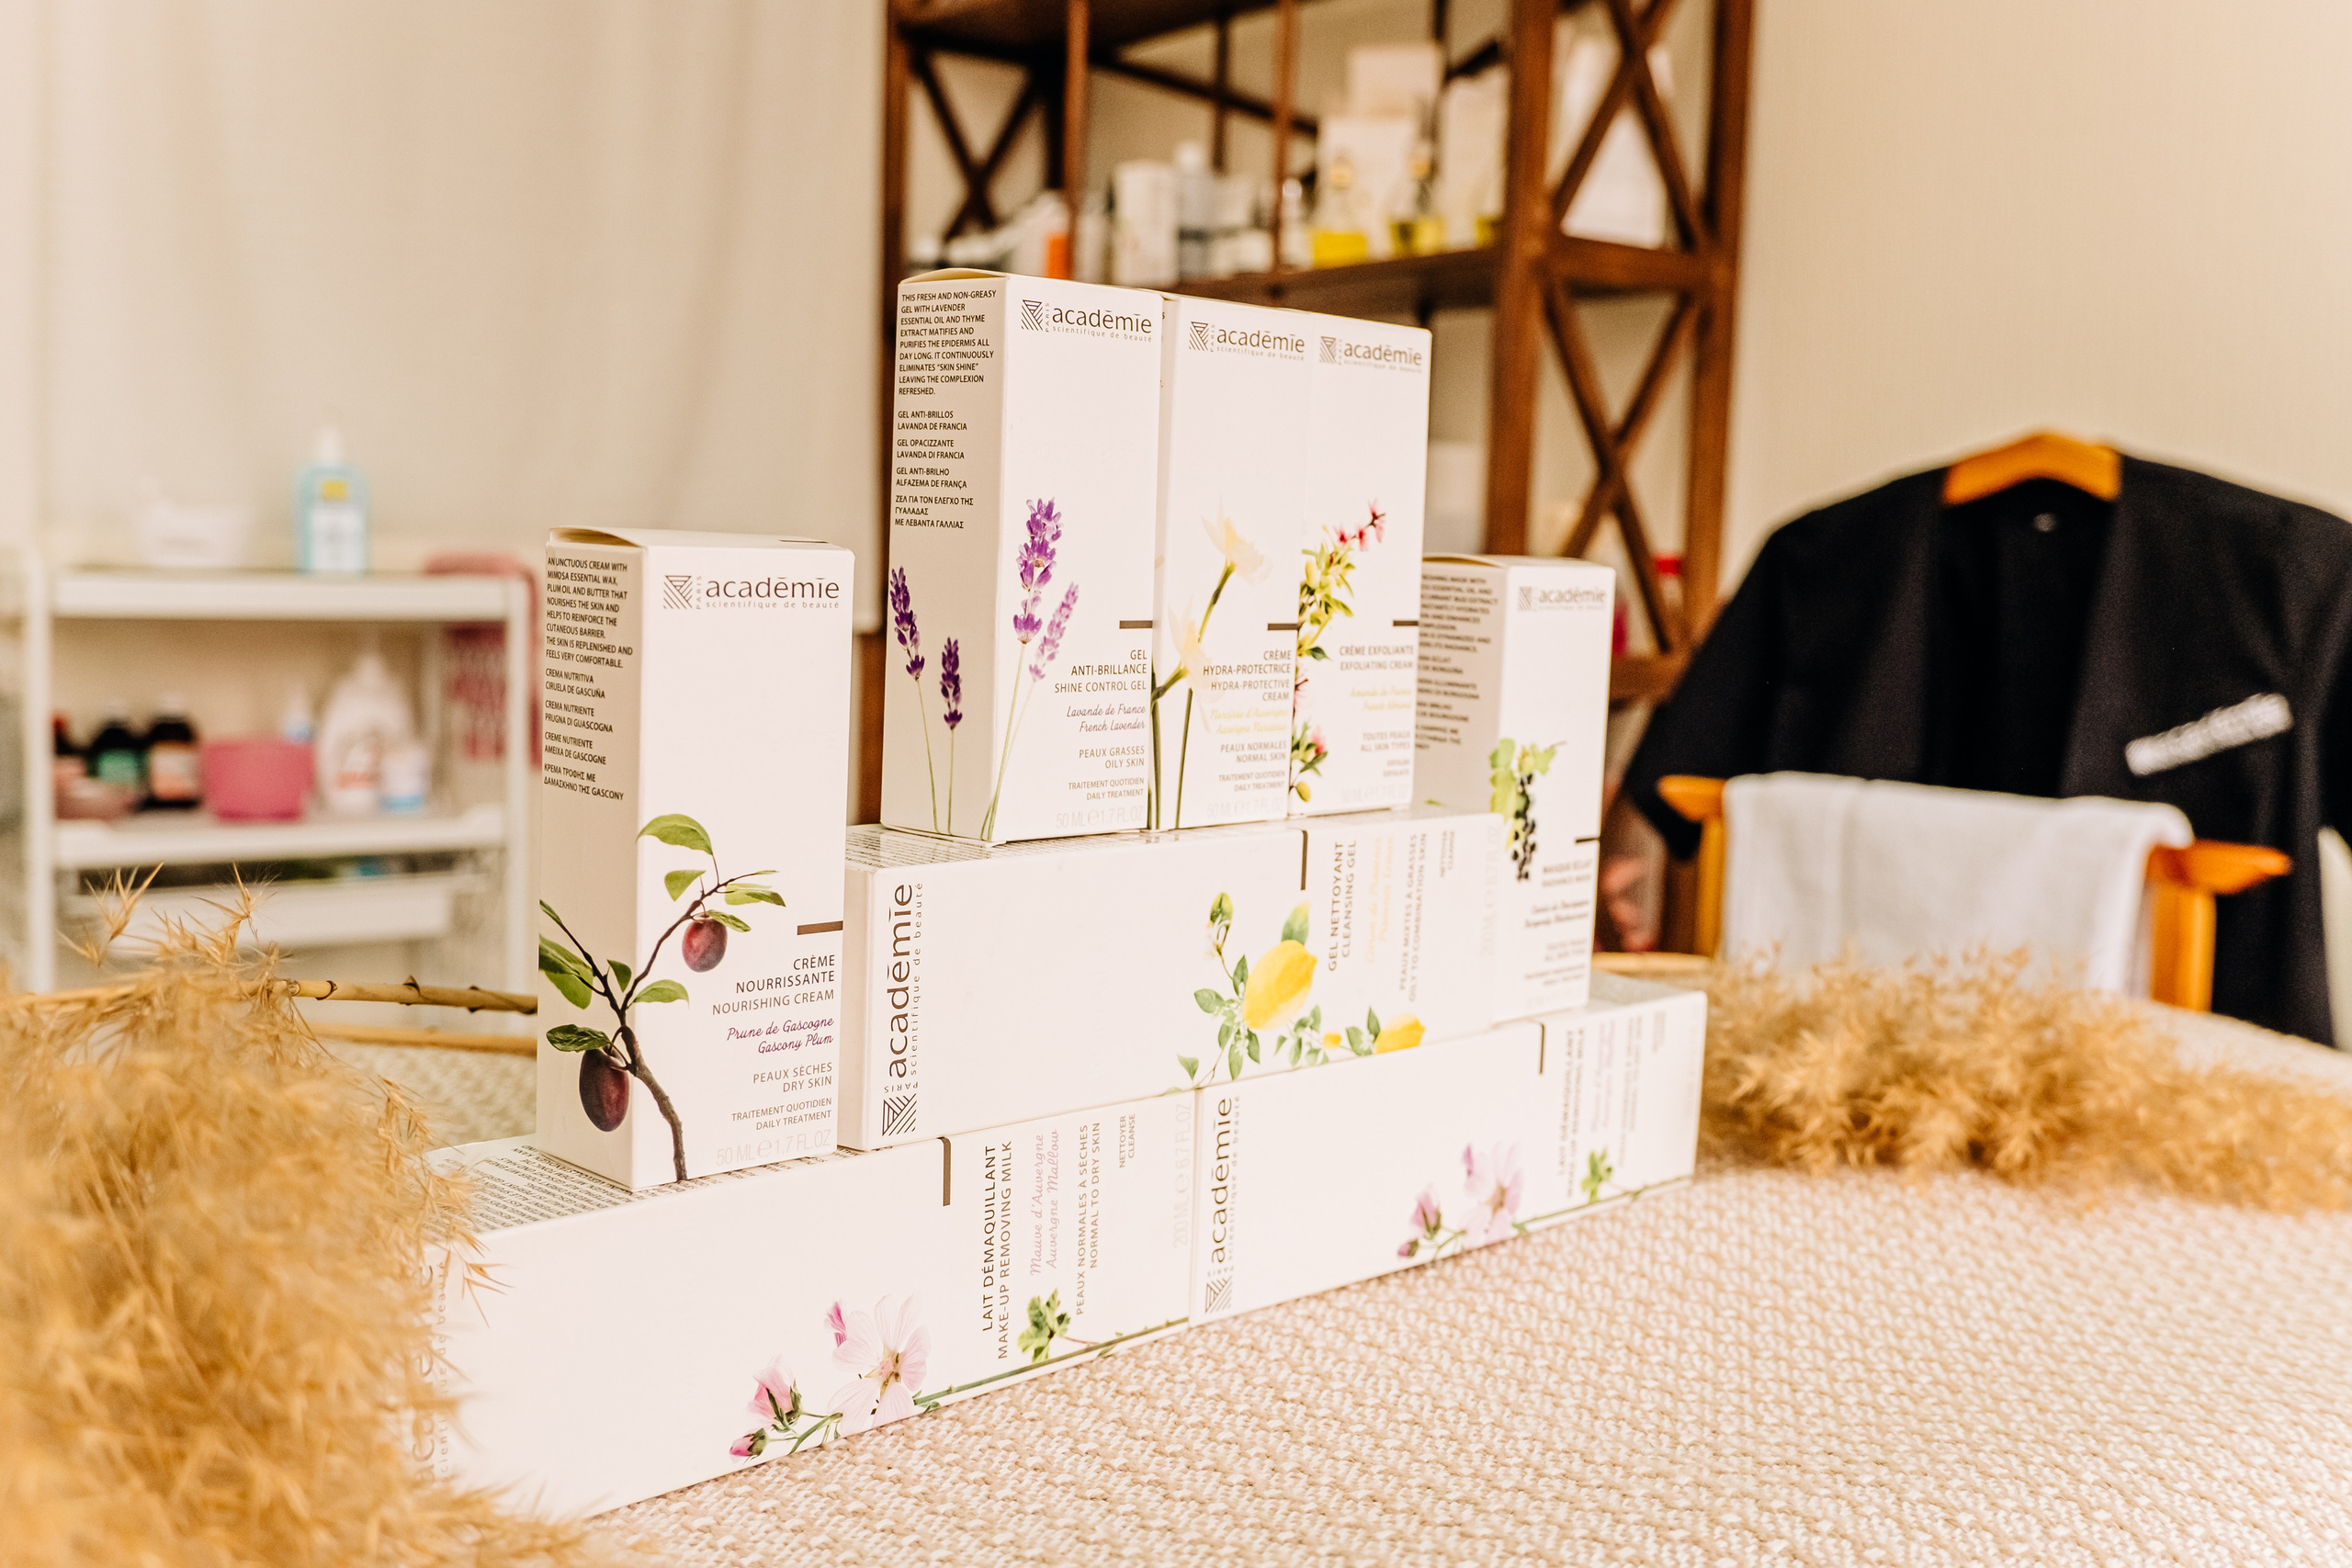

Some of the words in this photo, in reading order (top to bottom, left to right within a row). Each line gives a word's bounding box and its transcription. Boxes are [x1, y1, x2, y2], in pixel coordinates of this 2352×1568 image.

[916, 293, 936, 301] FRESH
[937, 292, 952, 300] AND
[953, 290, 997, 299] NON-GREASY
[913, 305, 930, 313] WITH
[931, 303, 966, 312] LAVENDER
[900, 317, 933, 325] ESSENTIAL
[933, 316, 944, 324] OIL
[945, 315, 961, 323] AND
[962, 314, 985, 323] THYME
[899, 328, 928, 337] EXTRACT
[928, 327, 957, 336] MATIFIES
[958, 327, 974, 335] AND
[1052, 326, 1106, 338] scientifique
[1124, 333, 1152, 343] beauté
[899, 340, 926, 348] PURIFIES
[927, 340, 940, 348] THE
[941, 339, 976, 347] EPIDERMIS
[977, 338, 989, 347] ALL
[913, 352, 933, 360] LONG.
[941, 351, 994, 359] CONTINUOUSLY
[899, 364, 935, 372] ELIMINATES
[899, 376, 926, 384] LEAVING
[940, 375, 984, 383] COMPLEXION
[898, 411, 910, 419] GEL
[910, 411, 954, 419] ANTI-BRILLOS
[929, 423, 937, 431] DE
[939, 423, 967, 431] FRANCIA
[547, 597, 577, 608] NOURISHES
[578, 600, 589, 610] THE
[590, 601, 605, 611] SKIN
[605, 603, 619, 613] AND
[706, 601, 777, 609] scientifique
[783, 601, 796, 609] de
[802, 601, 839, 609] beauté
[546, 610, 562, 620] HELPS
[562, 612, 571, 621] TO
[571, 613, 604, 625] REINFORCE
[605, 616, 617, 626] THE
[546, 624, 579, 636] CUTANEOUS
[579, 627, 605, 638] BARRIER.
[546, 649, 560, 660] FEELS
[560, 651, 575, 661] VERY
[575, 654, 623, 668] COMFORTABLE.
[1130, 649, 1147, 660] GEL
[1263, 649, 1291, 660] CRÈME
[1070, 664, 1147, 676] ANTI-BRILLANCE
[1203, 663, 1290, 675] HYDRA-PROTECTRICE
[1054, 682, 1082, 694] SHINE
[1085, 681, 1128, 692] CONTROL
[1130, 681, 1147, 691] GEL
[1211, 679, 1289, 691] HYDRA-PROTECTIVE
[1261, 692, 1289, 702] CREAM
[1066, 705, 1103, 717] Lavande
[1104, 704, 1115, 716] de
[1117, 703, 1146, 715] France
[1079, 719, 1108, 732] French
[1110, 718, 1145, 731] Lavender
[1079, 748, 1106, 758] PEAUX
[1109, 745, 1145, 757] GRASSES
[1220, 743, 1245, 753] PEAUX
[1247, 740, 1286, 751] NORMALES
[1104, 759, 1124, 769] OILY
[1125, 758, 1145, 768] SKIN
[1236, 753, 1267, 763] NORMAL
[1270, 752, 1286, 761] SKIN
[1068, 780, 1108, 790] TRAITEMENT
[1109, 777, 1144, 787] QUOTIDIEN
[1086, 792, 1106, 800] DAILY
[1107, 788, 1144, 798] TREATMENT
[1347, 840, 1356, 868] GEL
[1330, 842, 1343, 937] NETTOYANT
[913, 883, 923, 938] beauté
[1341, 873, 1354, 958] CLEANSING
[793, 954, 834, 970] CRÈME
[912, 948, 922, 965] de
[1329, 942, 1339, 971] GEL
[736, 971, 834, 993] NOURRISSANTE
[712, 995, 790, 1015] NOURISHING
[794, 989, 834, 1005] CREAM
[727, 1025, 763, 1041] Prune
[765, 1021, 779, 1036] de
[782, 1017, 834, 1035] Gascogne
[910, 976, 921, 1076] scientifique
[758, 1038, 802, 1054] Gascony
[805, 1032, 834, 1047] Plum
[752, 1068, 789, 1084] PEAUX
[793, 1062, 832, 1077] SÈCHES
[783, 1079, 805, 1092] DRY
[808, 1076, 831, 1089] SKIN
[884, 1081, 919, 1093] PARIS
[731, 1105, 785, 1122] TRAITEMENT
[786, 1098, 832, 1112] QUOTIDIEN
[756, 1118, 781, 1131] DAILY
[783, 1110, 831, 1125] TREATMENT
[1091, 1122, 1101, 1153] SKIN
[1078, 1124, 1089, 1176] SÈCHES
[1001, 1141, 1012, 1182] MILK
[1046, 1129, 1059, 1193] Mallow
[1091, 1158, 1100, 1184] DRY
[1091, 1189, 1100, 1207] TO
[982, 1145, 996, 1287] DÉMAQUILLANT
[1000, 1188, 1012, 1278] REMOVING
[1046, 1200, 1059, 1269] Auvergne
[1077, 1192, 1087, 1267] NORMALES
[1090, 1210, 1099, 1269] NORMAL
[1030, 1224, 1044, 1276] Mauve
[1076, 1270, 1085, 1315] PEAUX
[982, 1294, 993, 1331] LAIT
[998, 1284, 1010, 1359] MAKE-UP
